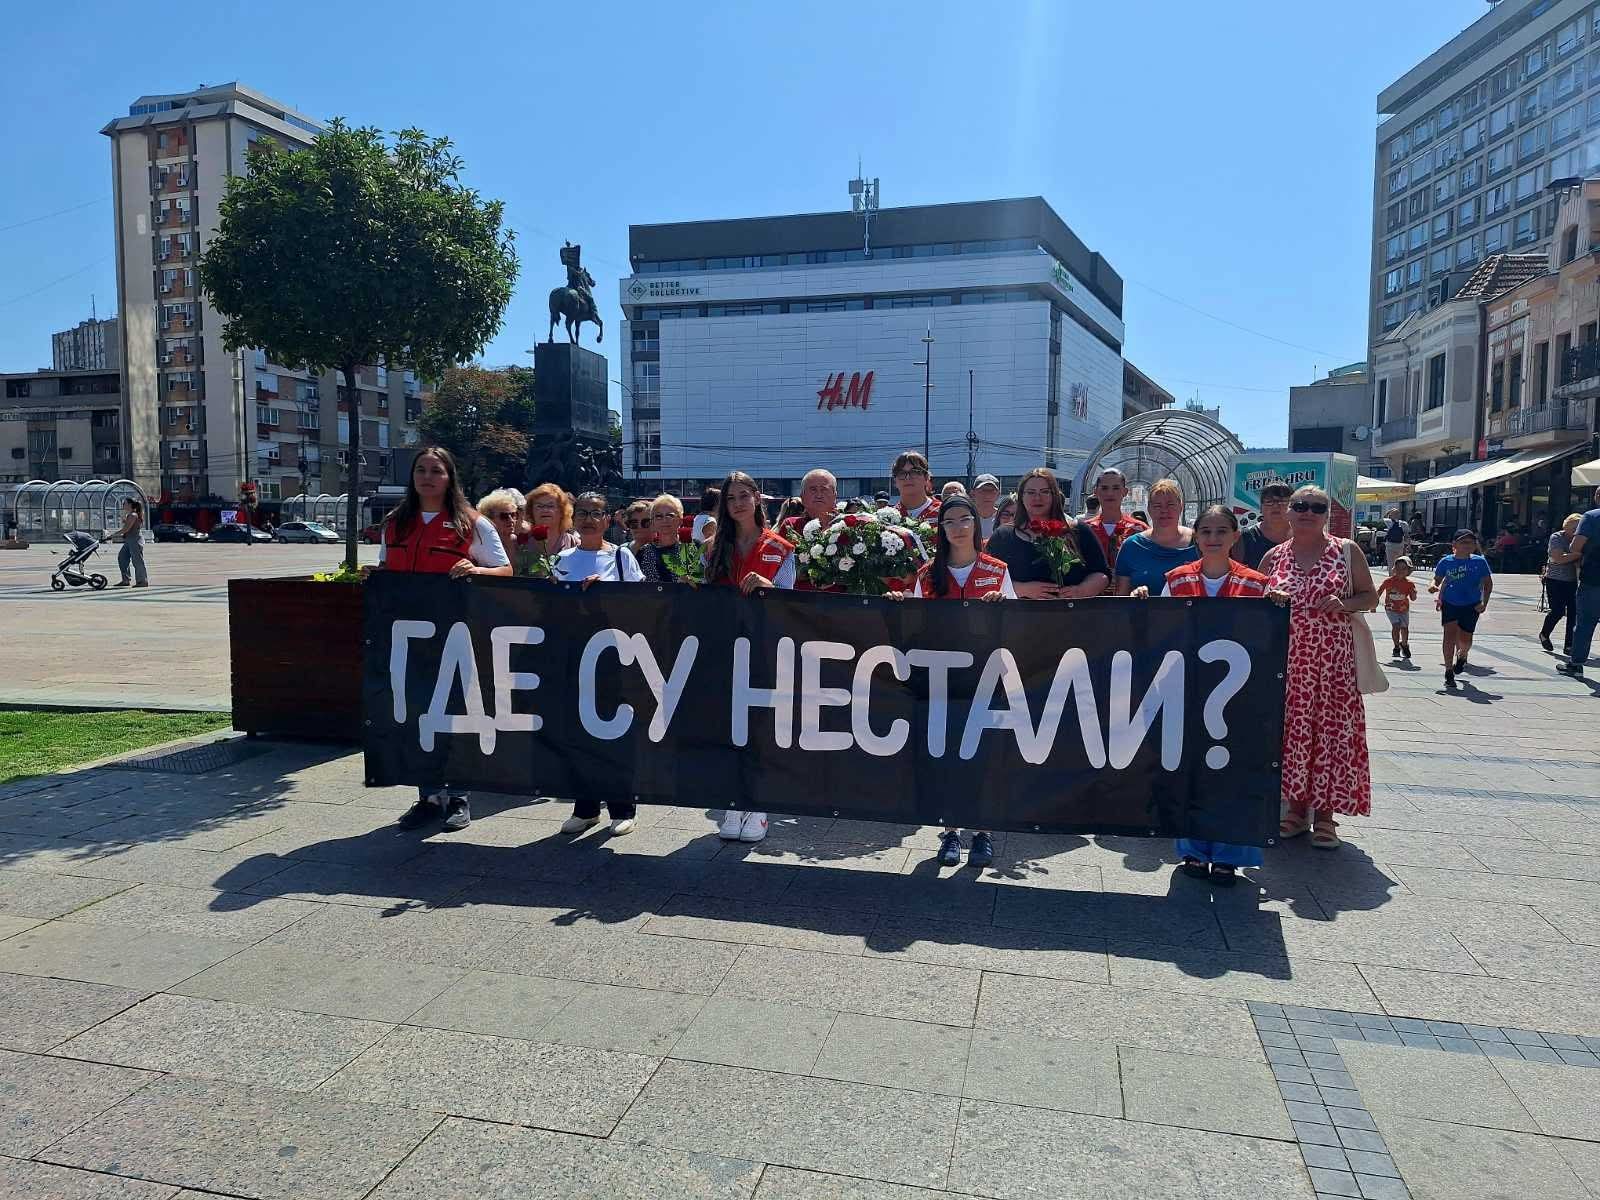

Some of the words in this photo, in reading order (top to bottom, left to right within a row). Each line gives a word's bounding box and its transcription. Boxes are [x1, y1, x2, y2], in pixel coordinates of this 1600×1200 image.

[817, 371, 874, 412] H&M
[390, 620, 546, 755] ГДЕ
[578, 628, 699, 743] СУ
[731, 637, 1252, 772] НЕСТАЛИ?
